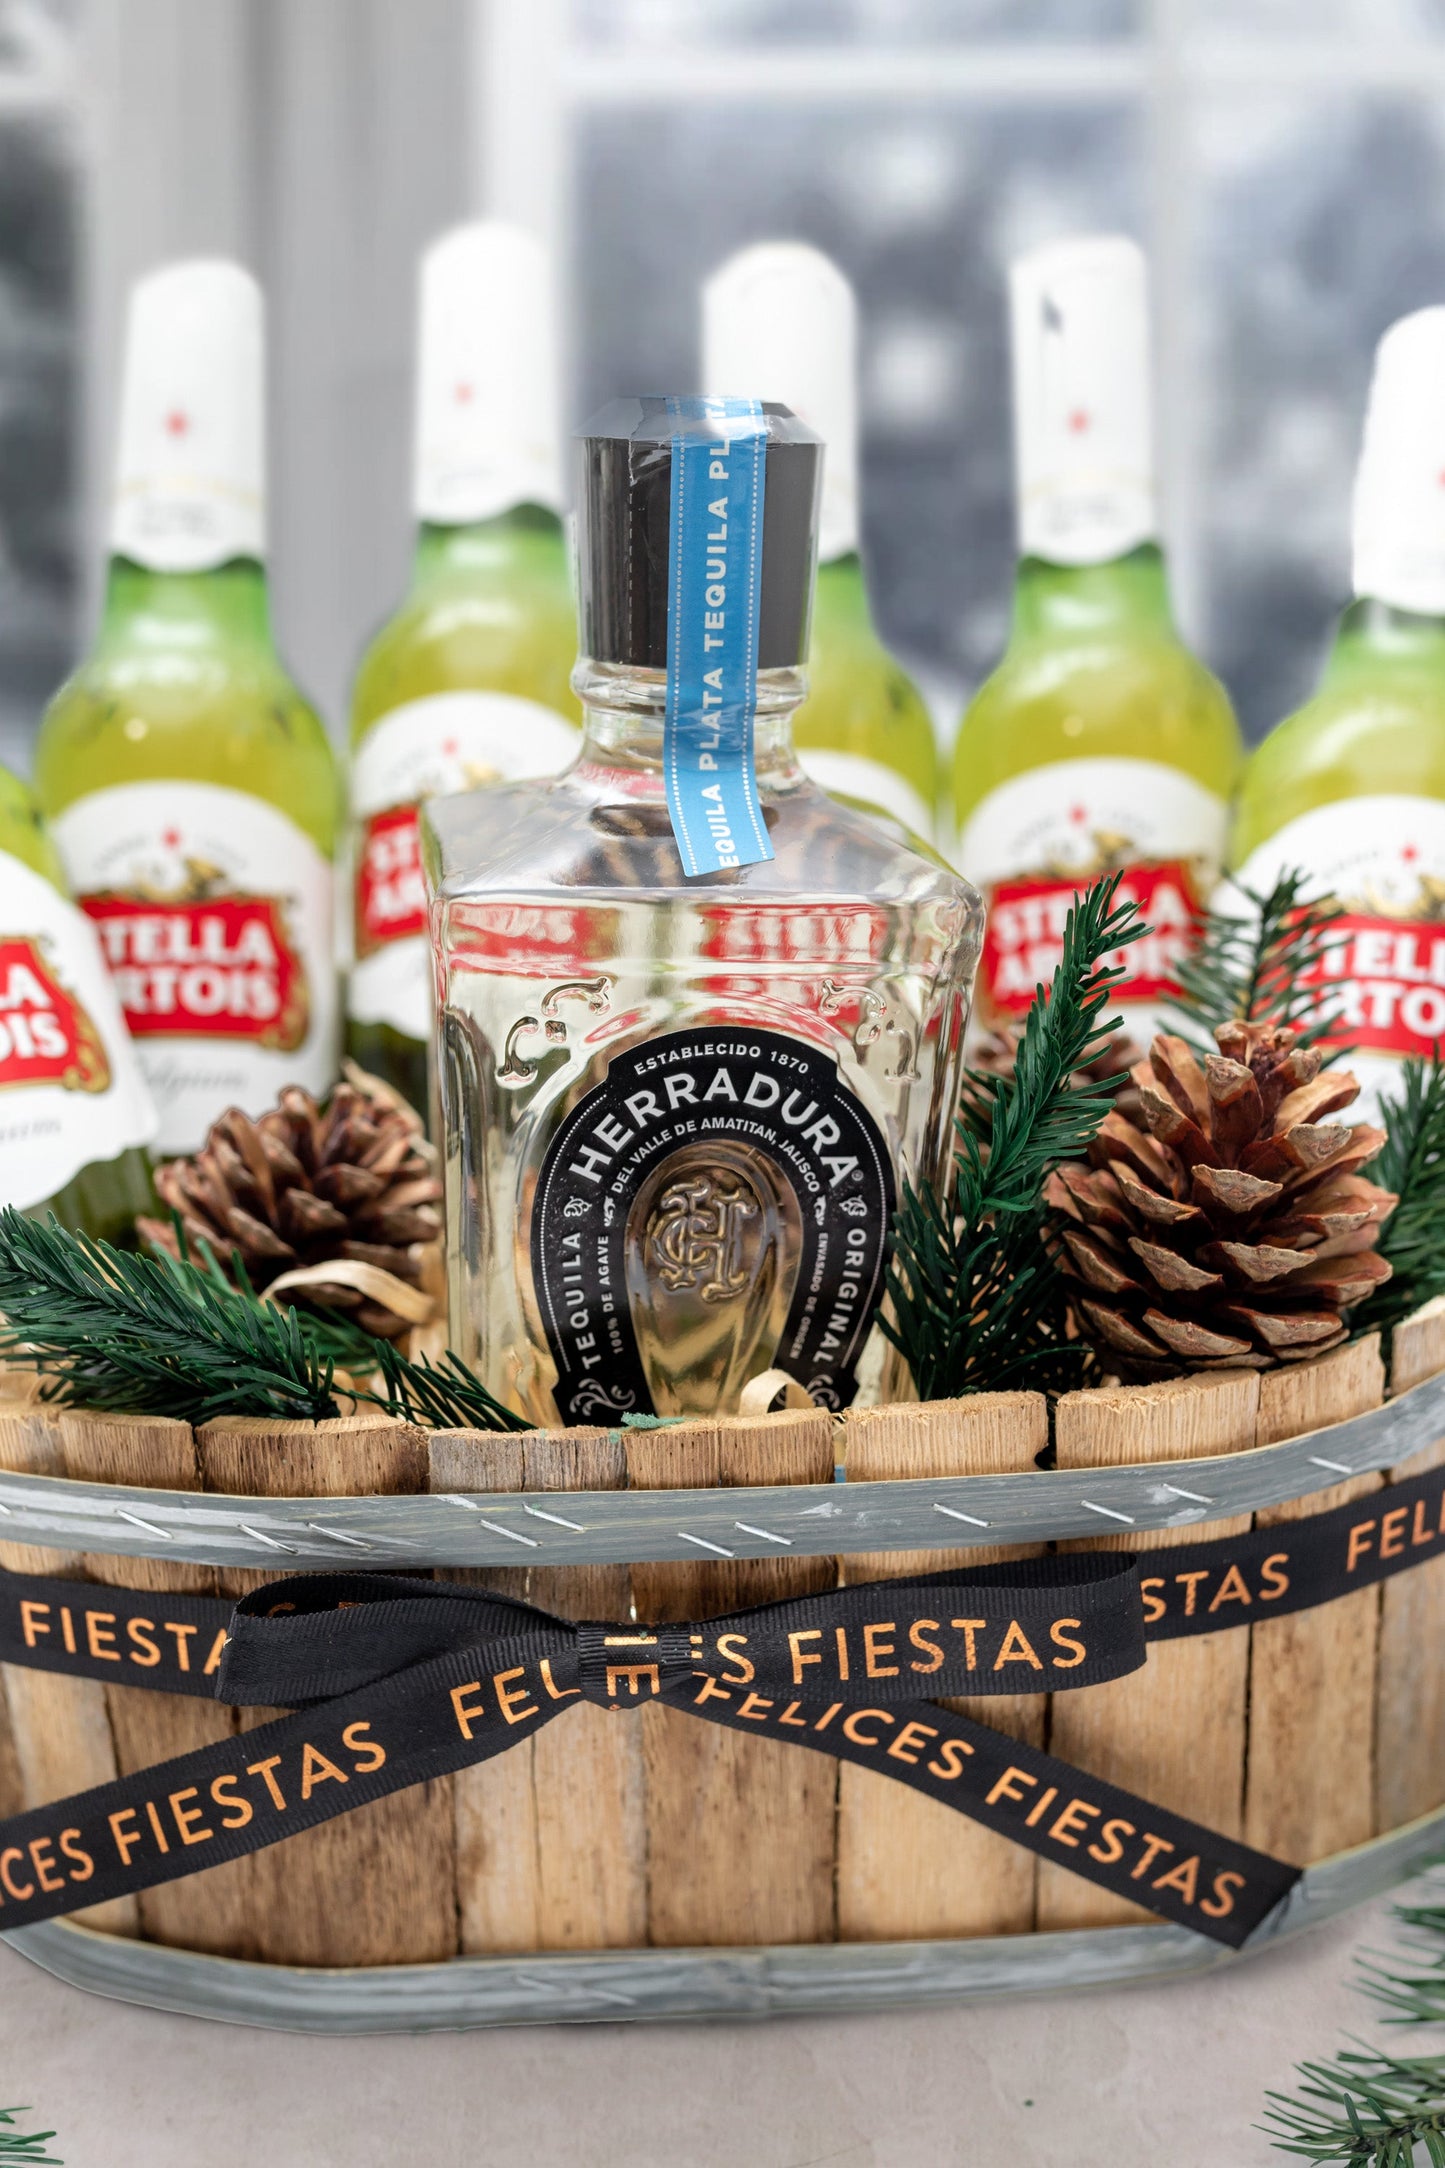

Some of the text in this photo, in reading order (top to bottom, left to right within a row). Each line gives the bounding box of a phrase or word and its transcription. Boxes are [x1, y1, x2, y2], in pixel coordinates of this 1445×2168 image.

[705, 398, 730, 479] PLT
[705, 498, 728, 652] TEQUILA
[699, 667, 724, 771] PLATA
[99, 911, 278, 968] TELLA
[113, 966, 281, 1021] RTOIS
[633, 1043, 809, 1076] ESTABLECIDO 1870
[568, 1067, 859, 1188] HERRADURA
[611, 1117, 820, 1194] DEL VALLE DE AMATITAN, JALISCO
[562, 1232, 602, 1370] TEQUILA
[598, 1236, 624, 1354] 100% DE AGAVE
[809, 1232, 829, 1293] ENVASADO
[812, 1228, 867, 1363] ORIGINAL
[804, 1296, 818, 1312] DE
[1141, 1553, 1290, 1622] STAS
[787, 1618, 1087, 1685] FIESTAS
[0, 1827, 95, 1906] CES
[107, 1721, 387, 1866] FIESTAS
[984, 1765, 1247, 1918] FIESTAS
